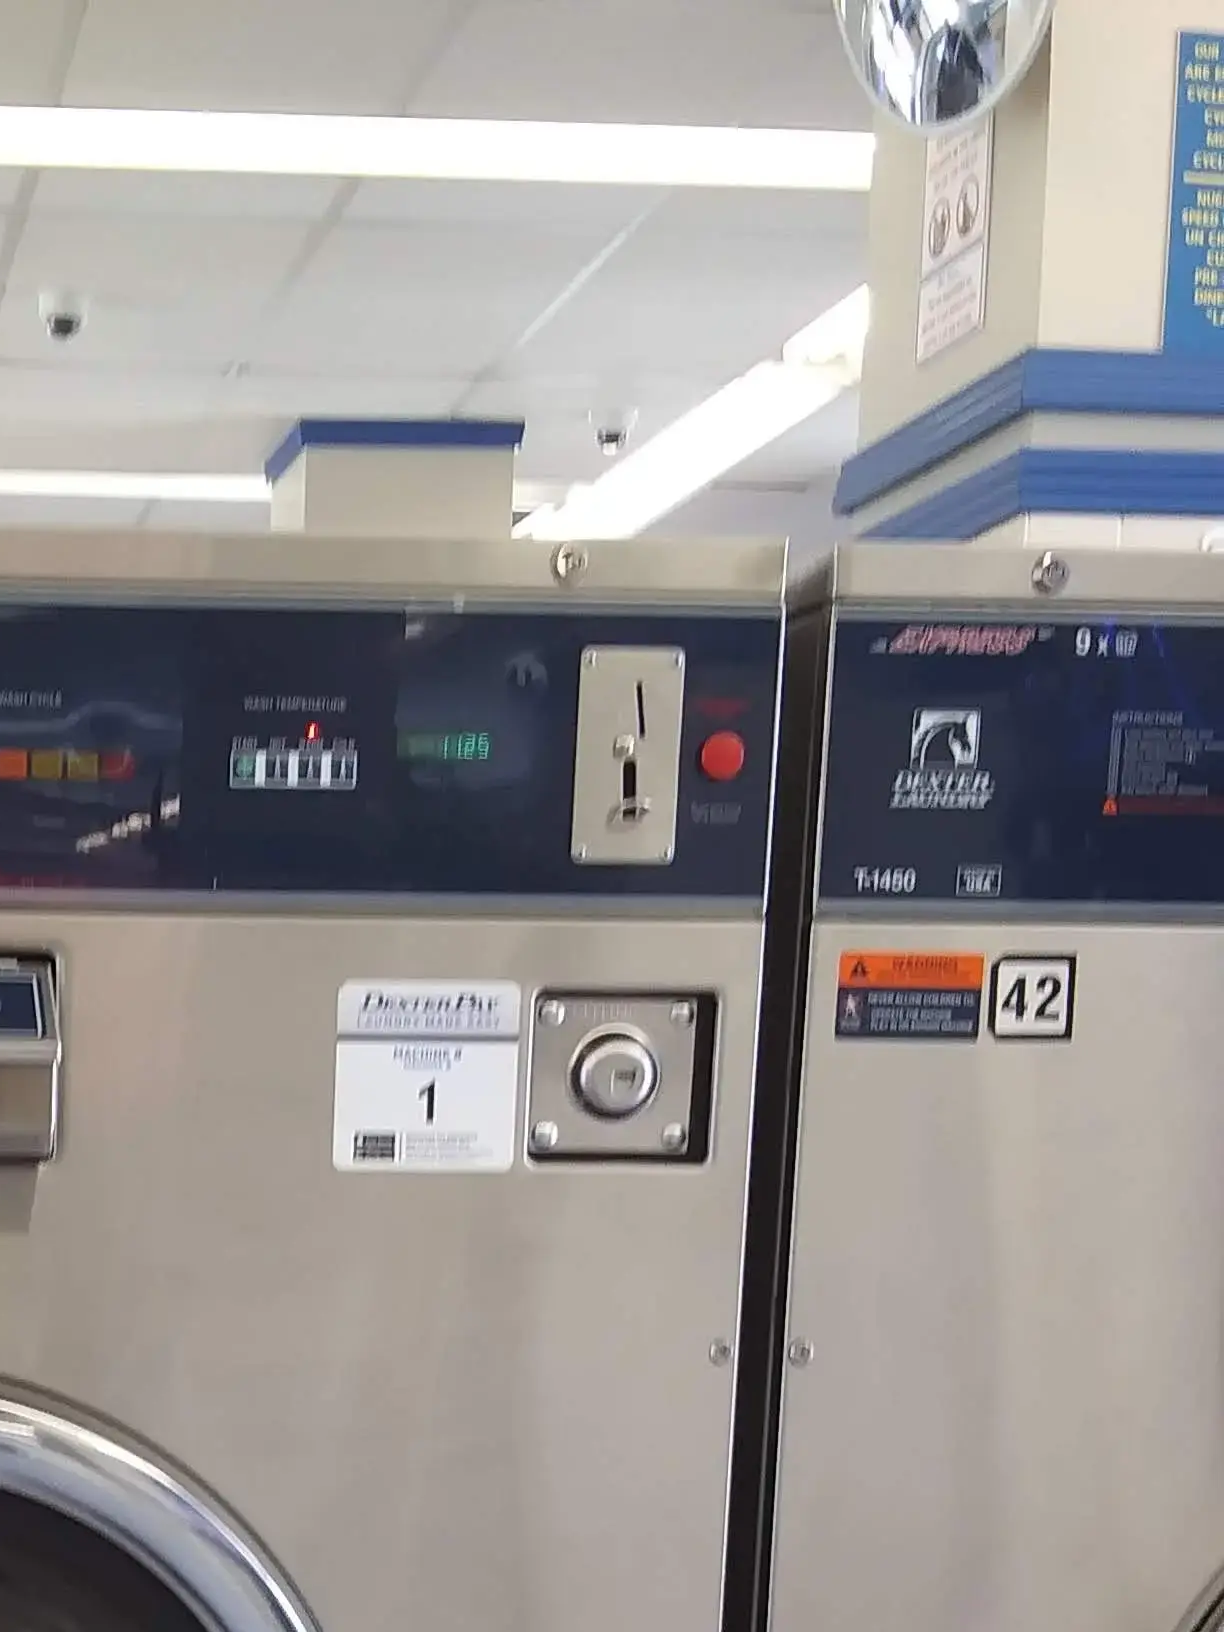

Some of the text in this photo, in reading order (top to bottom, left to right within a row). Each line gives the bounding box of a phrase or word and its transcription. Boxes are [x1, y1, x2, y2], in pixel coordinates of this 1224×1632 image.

[1075, 626, 1091, 656] 9
[892, 769, 991, 791] DEXTER
[1001, 975, 1062, 1023] 42
[418, 1076, 436, 1126] 1
